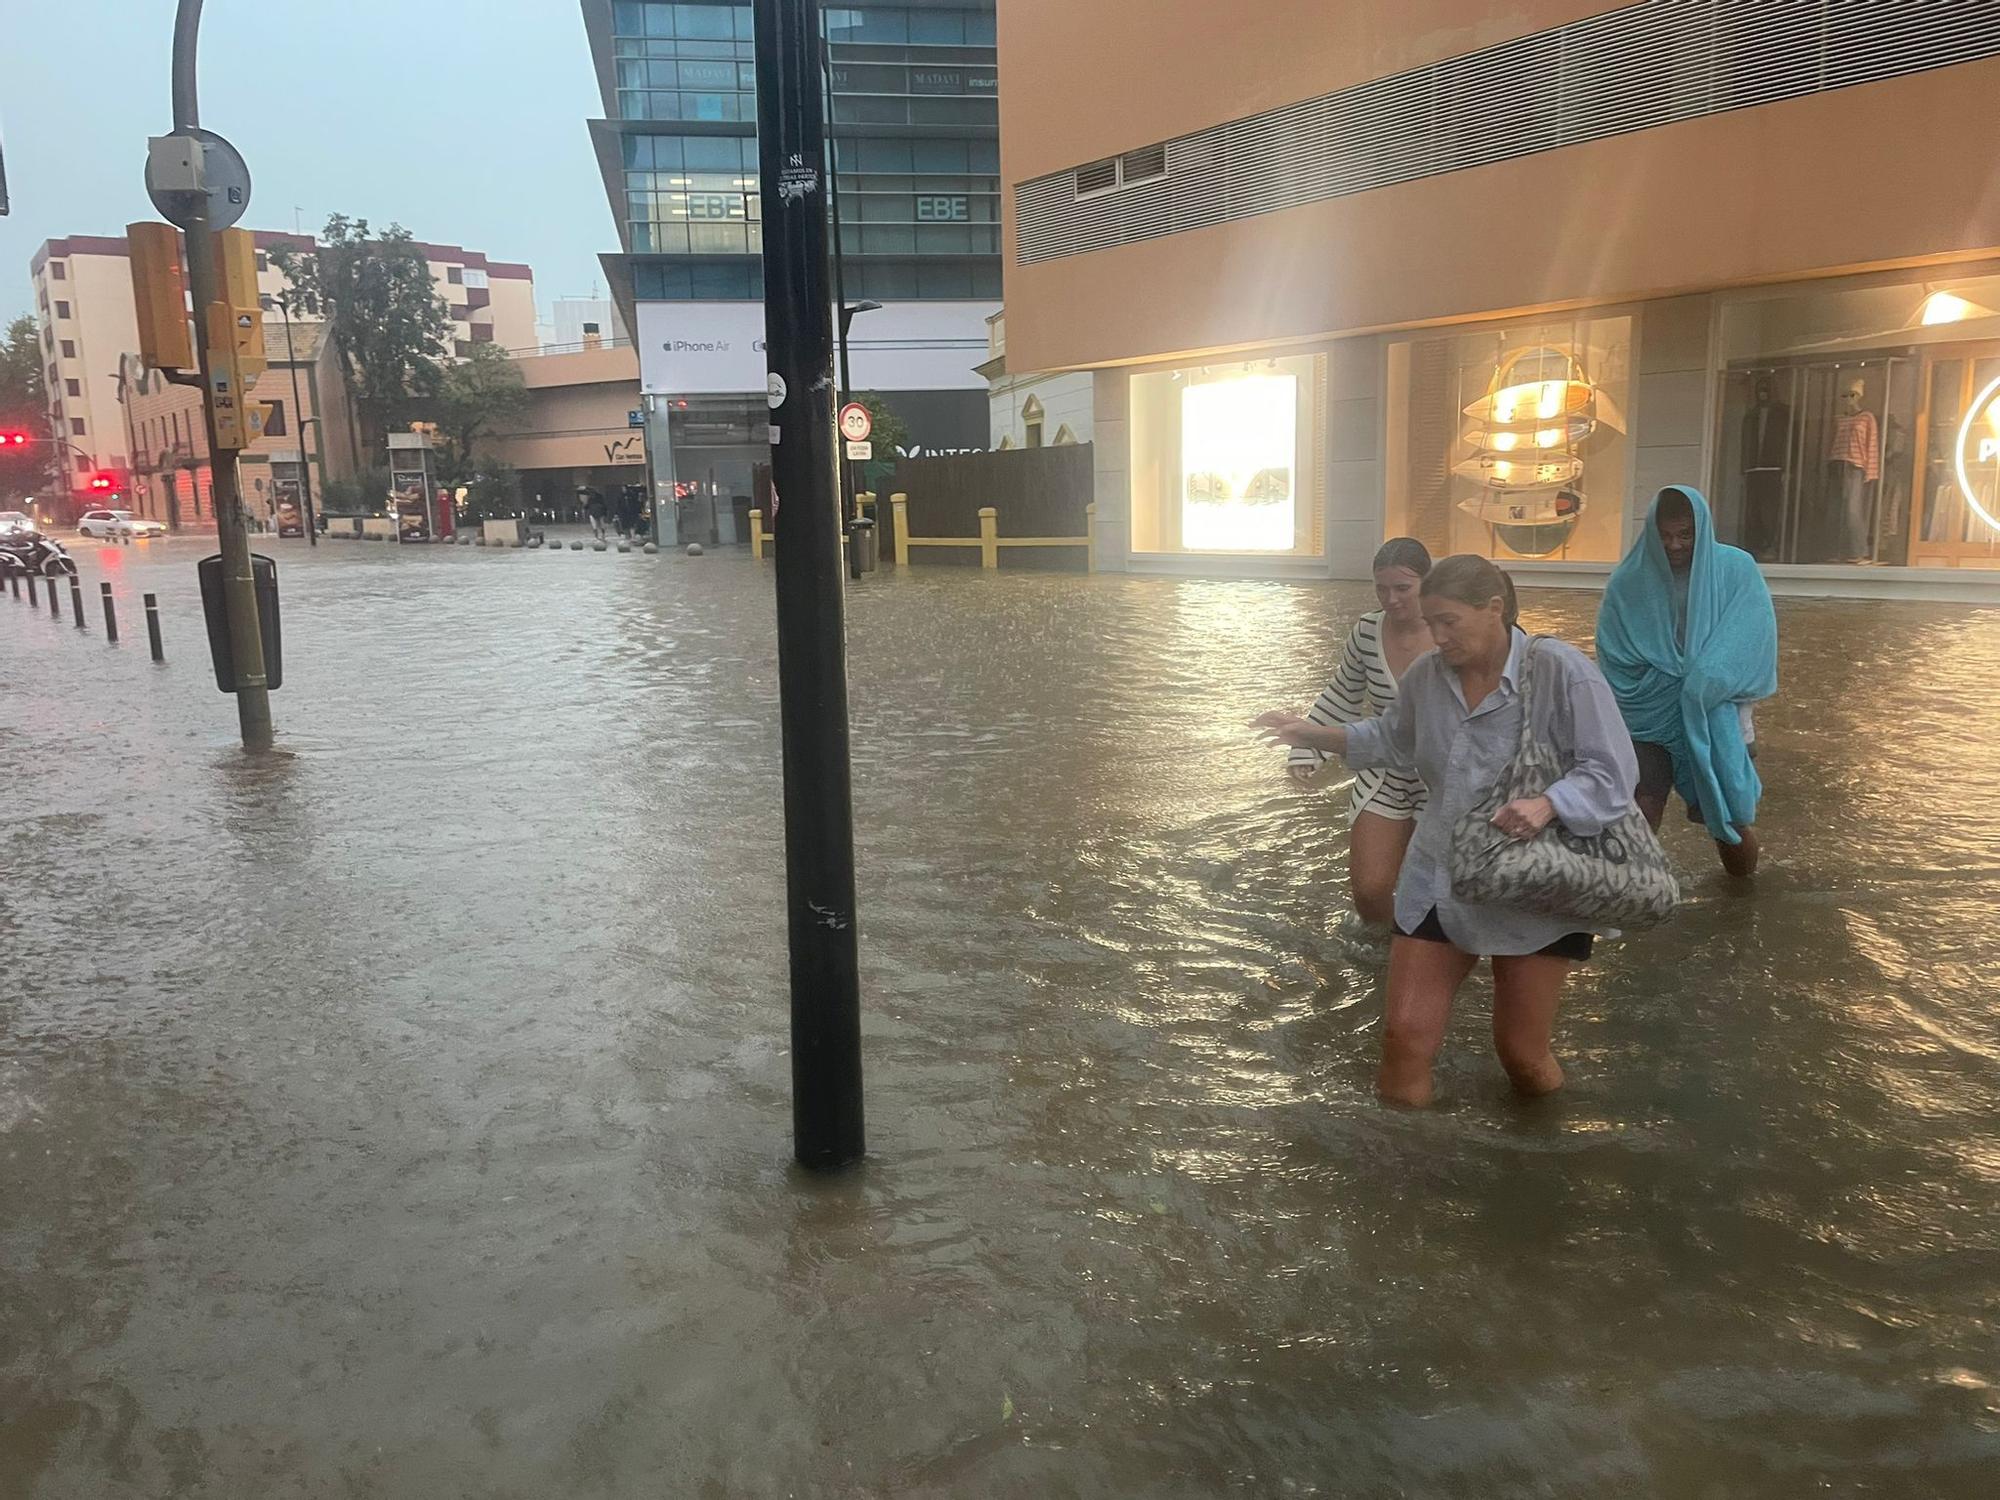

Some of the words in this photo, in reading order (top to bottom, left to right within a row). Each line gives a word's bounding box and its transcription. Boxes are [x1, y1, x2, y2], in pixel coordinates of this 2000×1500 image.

[914, 73, 960, 86] MADAVI
[689, 195, 742, 218] EBE
[917, 197, 969, 220] EBE
[673, 341, 714, 352] iPhone
[716, 341, 731, 352] Air
[847, 416, 864, 428] 30
